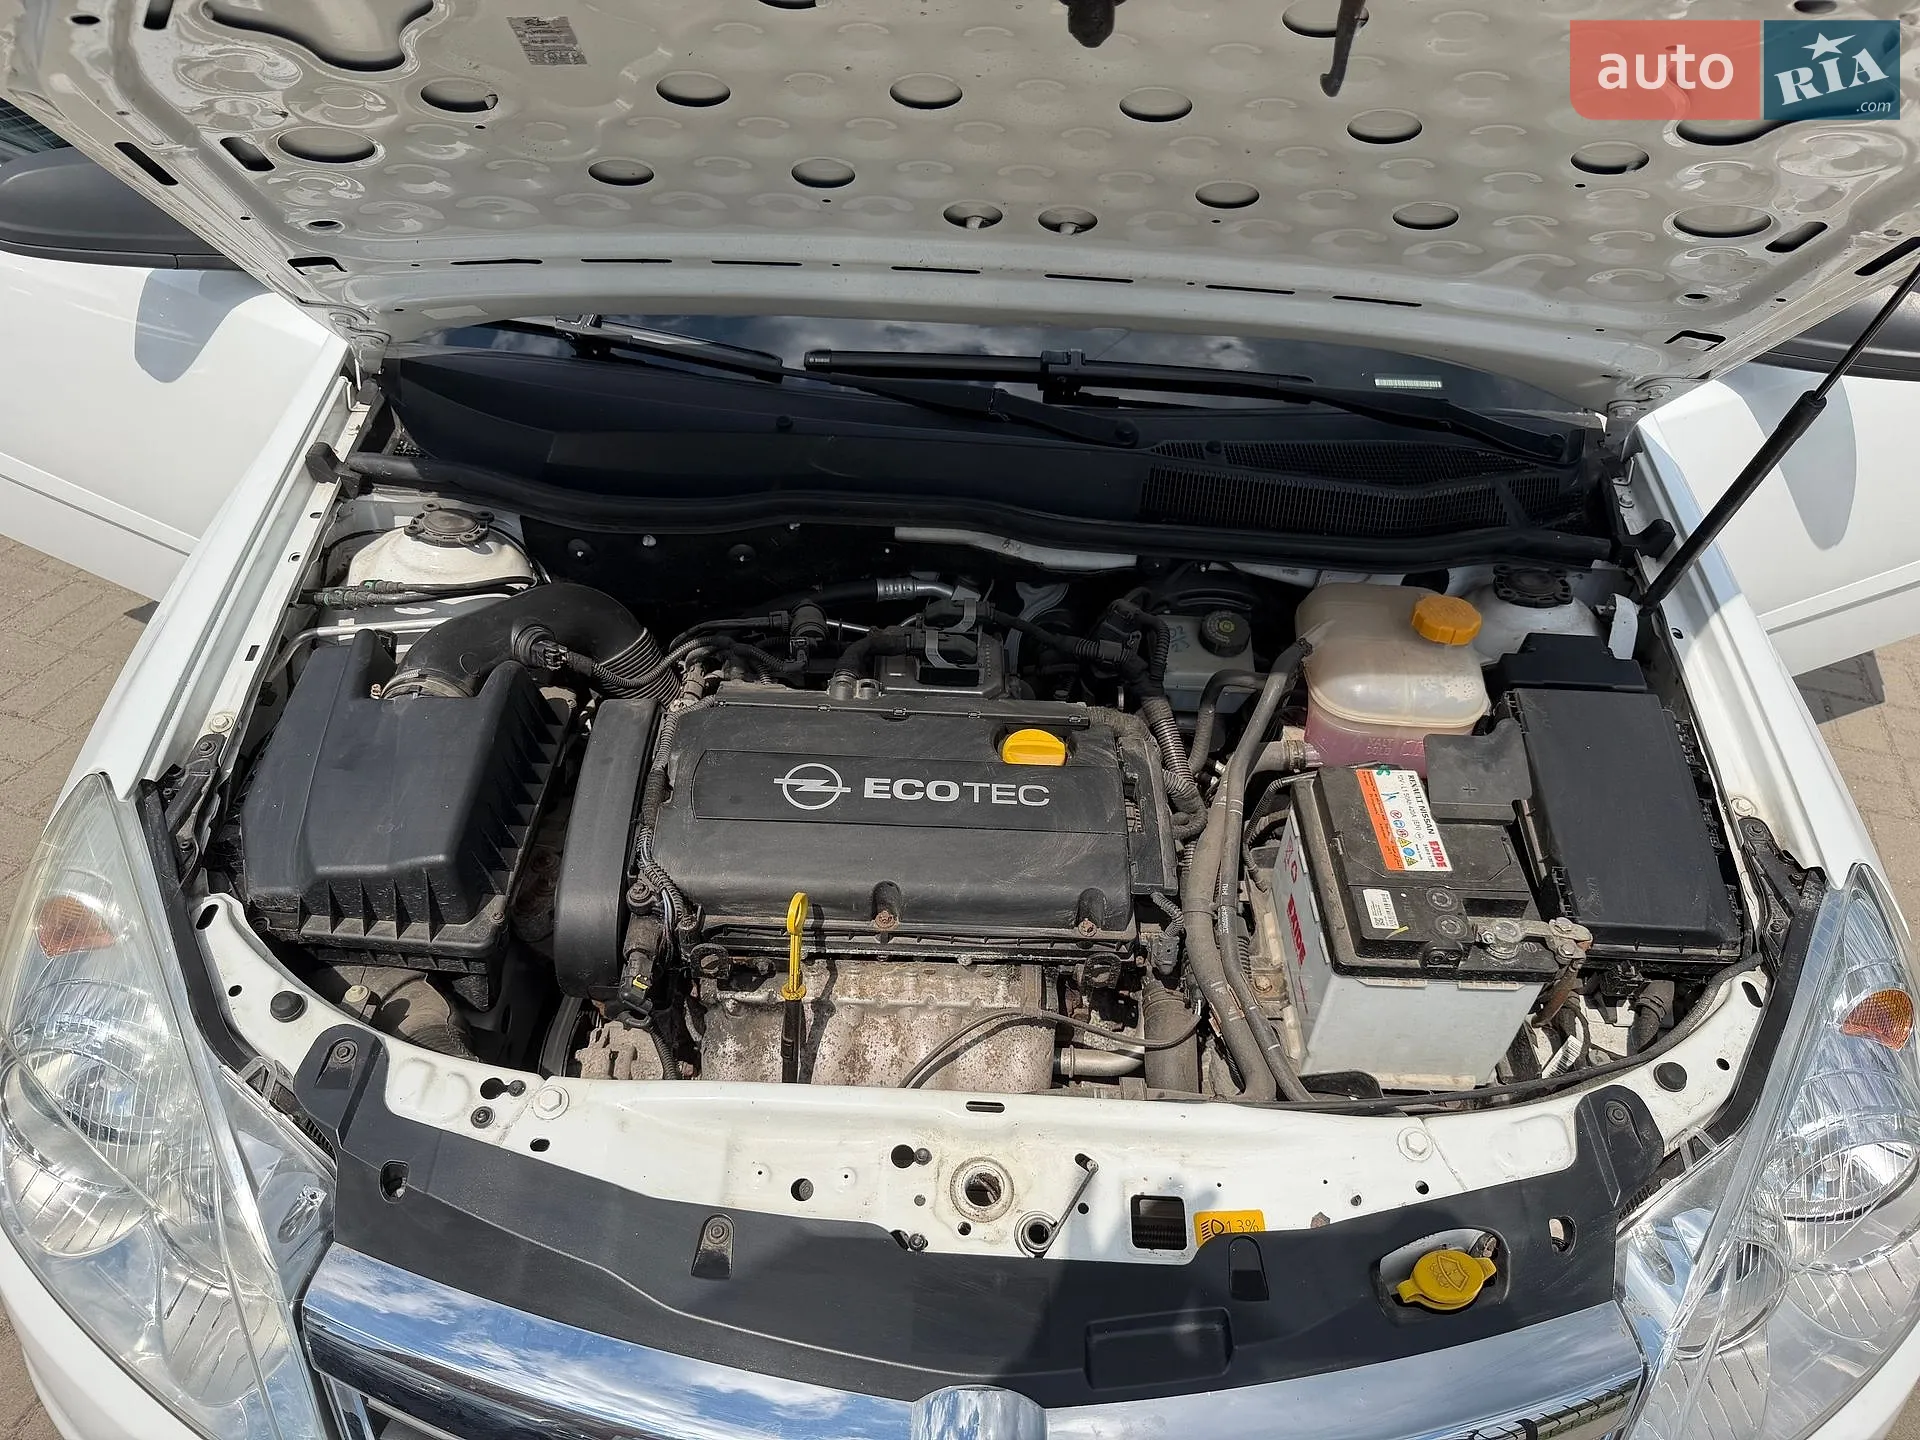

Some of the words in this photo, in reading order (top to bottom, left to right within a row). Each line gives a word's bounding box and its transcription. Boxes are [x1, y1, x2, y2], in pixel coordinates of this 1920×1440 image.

[864, 777, 1050, 806] ECOTEC
[1408, 774, 1423, 804] RENAULT
[1418, 805, 1435, 835] NISSAN
[1428, 841, 1447, 868] EXIDE
[1287, 894, 1306, 966] EXIDE
